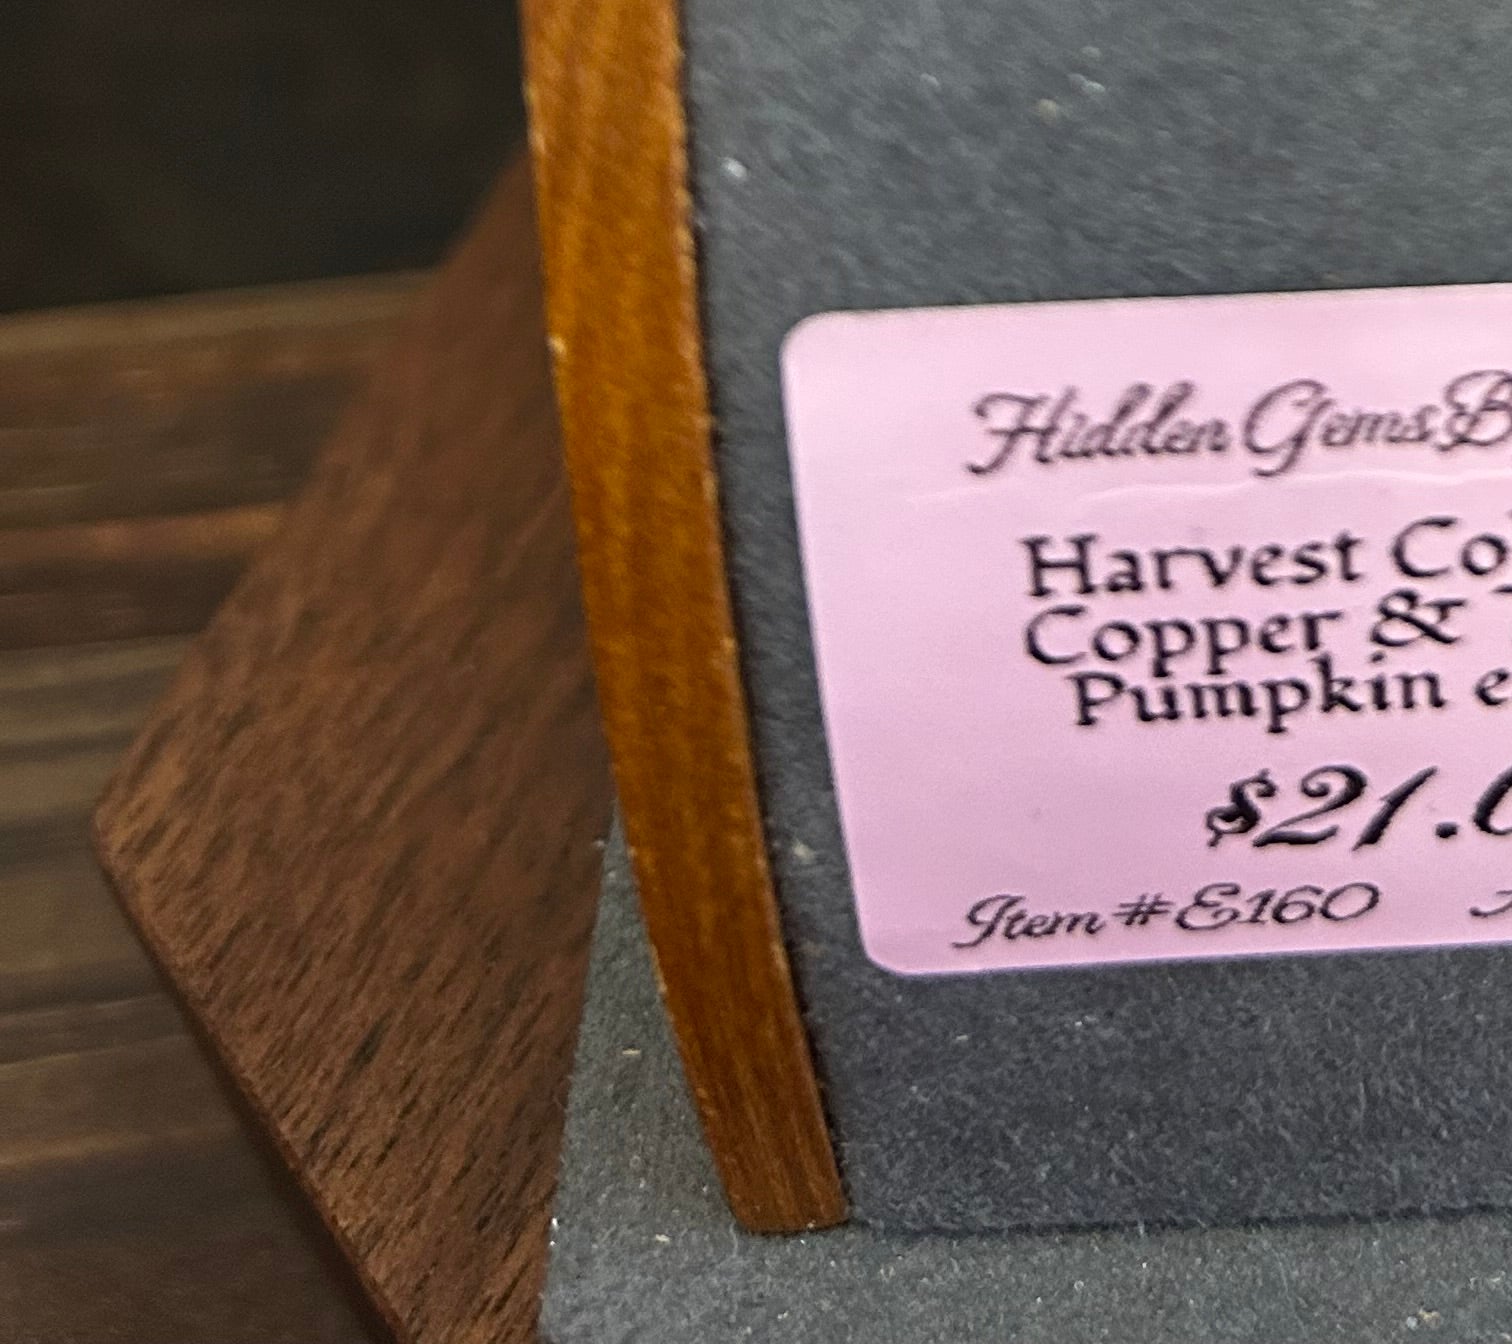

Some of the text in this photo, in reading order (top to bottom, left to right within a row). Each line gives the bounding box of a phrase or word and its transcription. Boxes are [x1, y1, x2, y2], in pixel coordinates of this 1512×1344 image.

[1017, 531, 1365, 602] Harvest
[1021, 603, 1343, 680] Copper
[1368, 587, 1470, 650] &
[1063, 650, 1450, 737] Pumpkin
